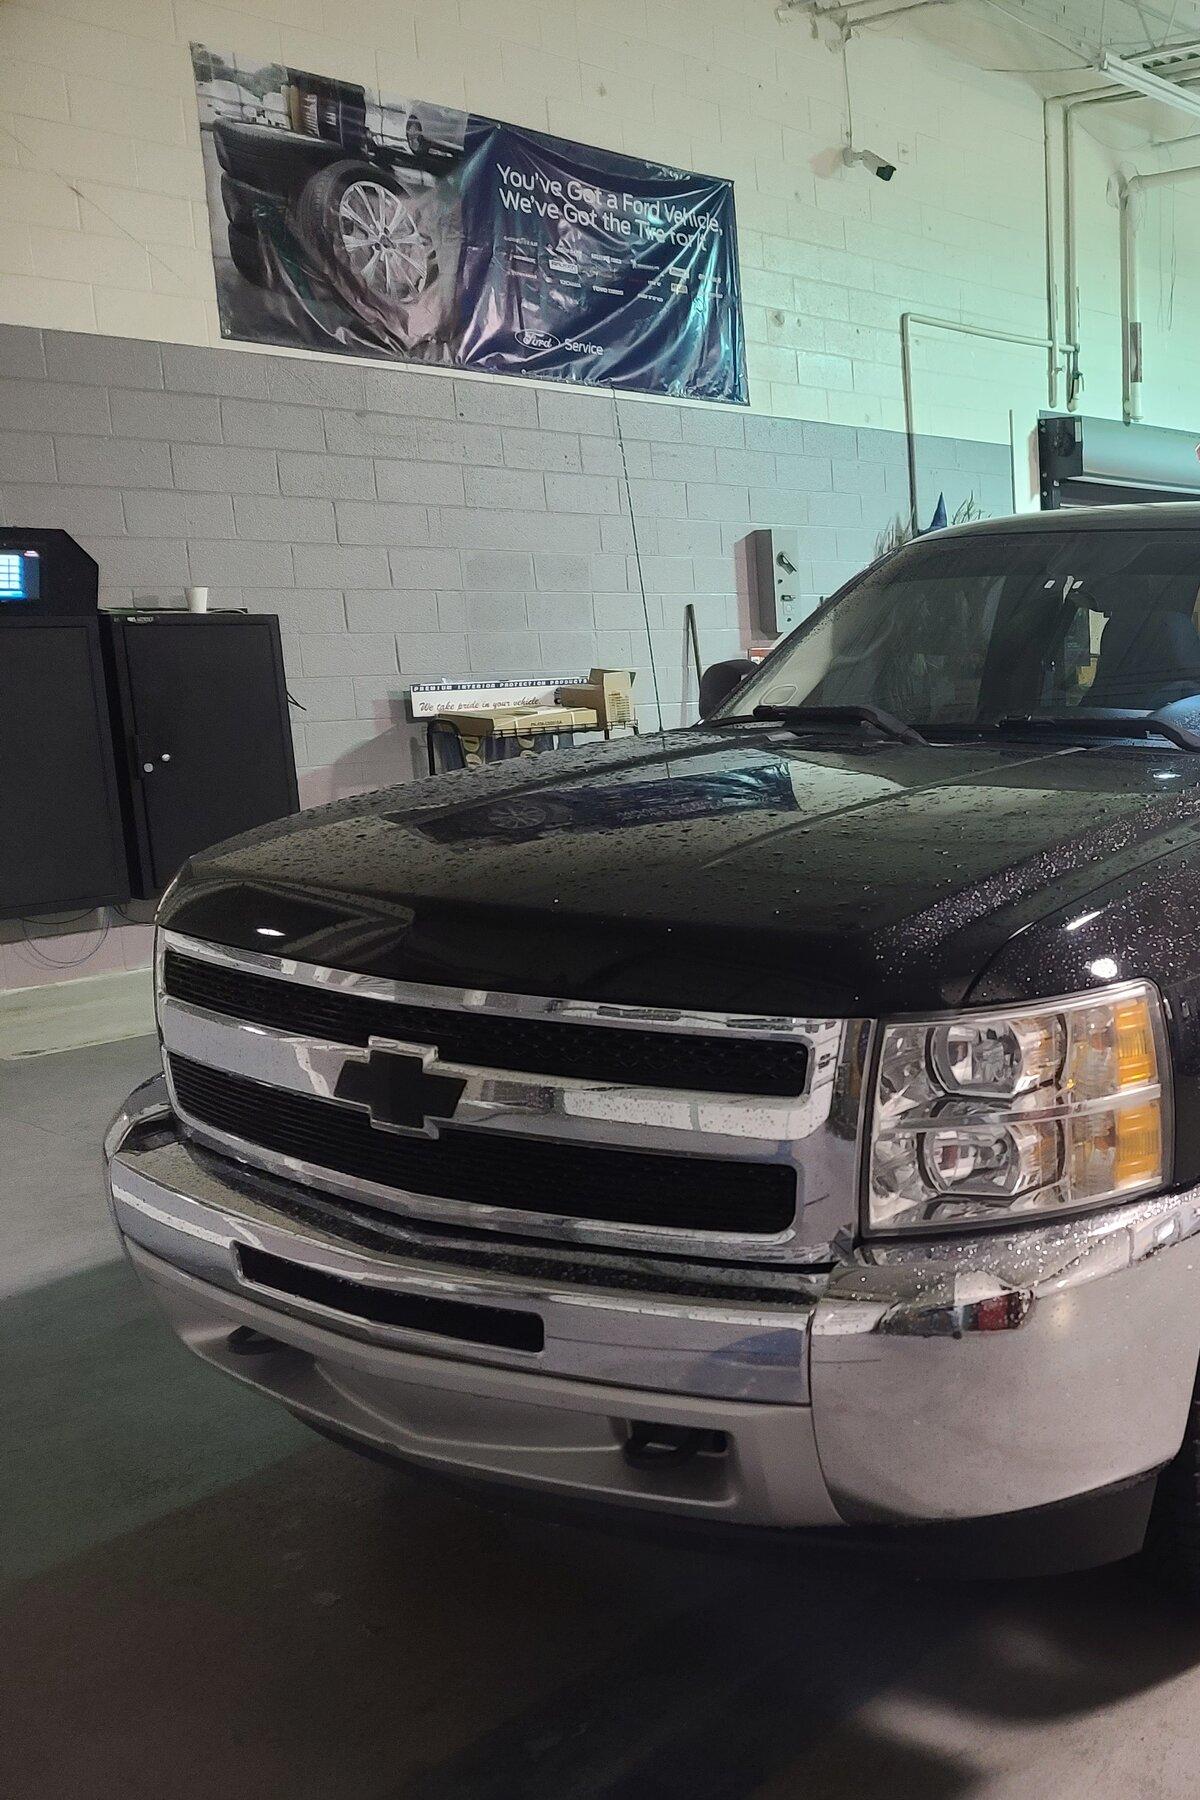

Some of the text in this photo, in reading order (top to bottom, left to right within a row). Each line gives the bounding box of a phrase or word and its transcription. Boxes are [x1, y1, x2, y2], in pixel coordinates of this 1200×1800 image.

[497, 163, 563, 198] You've
[567, 181, 602, 206] Got
[607, 193, 618, 209] a
[622, 193, 660, 219] Ford
[499, 188, 560, 219] We've
[563, 203, 598, 226] Got
[603, 212, 632, 236] the
[564, 338, 604, 356] Service
[413, 677, 588, 692] PREMIUM INTERIOR PROTECTION PRODUCTS
[418, 701, 434, 712] We
[436, 700, 455, 713] take
[456, 698, 479, 711] pride
[481, 699, 490, 708] in
[492, 700, 511, 710] your
